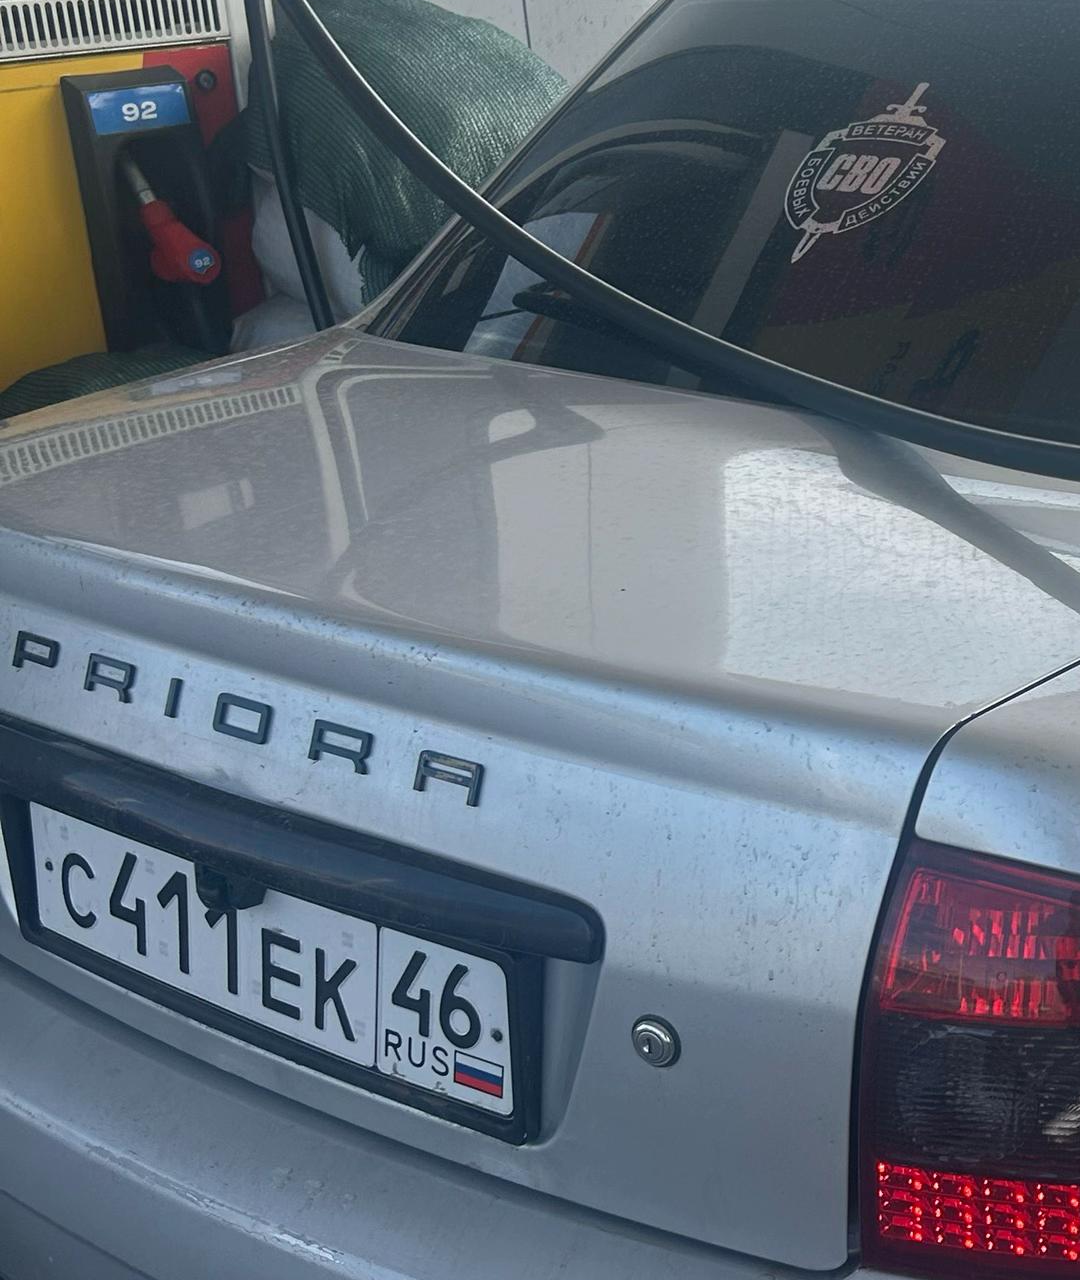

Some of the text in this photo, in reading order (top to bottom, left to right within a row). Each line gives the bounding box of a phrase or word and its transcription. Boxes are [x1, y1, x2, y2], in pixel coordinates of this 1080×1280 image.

[122, 101, 157, 122] 92
[852, 125, 927, 141] ВЕТЕРАН
[792, 157, 822, 218] БОЕВЫХ
[816, 153, 901, 194] СВО
[845, 160, 927, 227] ДЕЙСТВИЙ
[195, 256, 211, 268] 92
[12, 630, 485, 807] PRIORA
[391, 949, 481, 1049] 46
[384, 1029, 450, 1077] RUS
